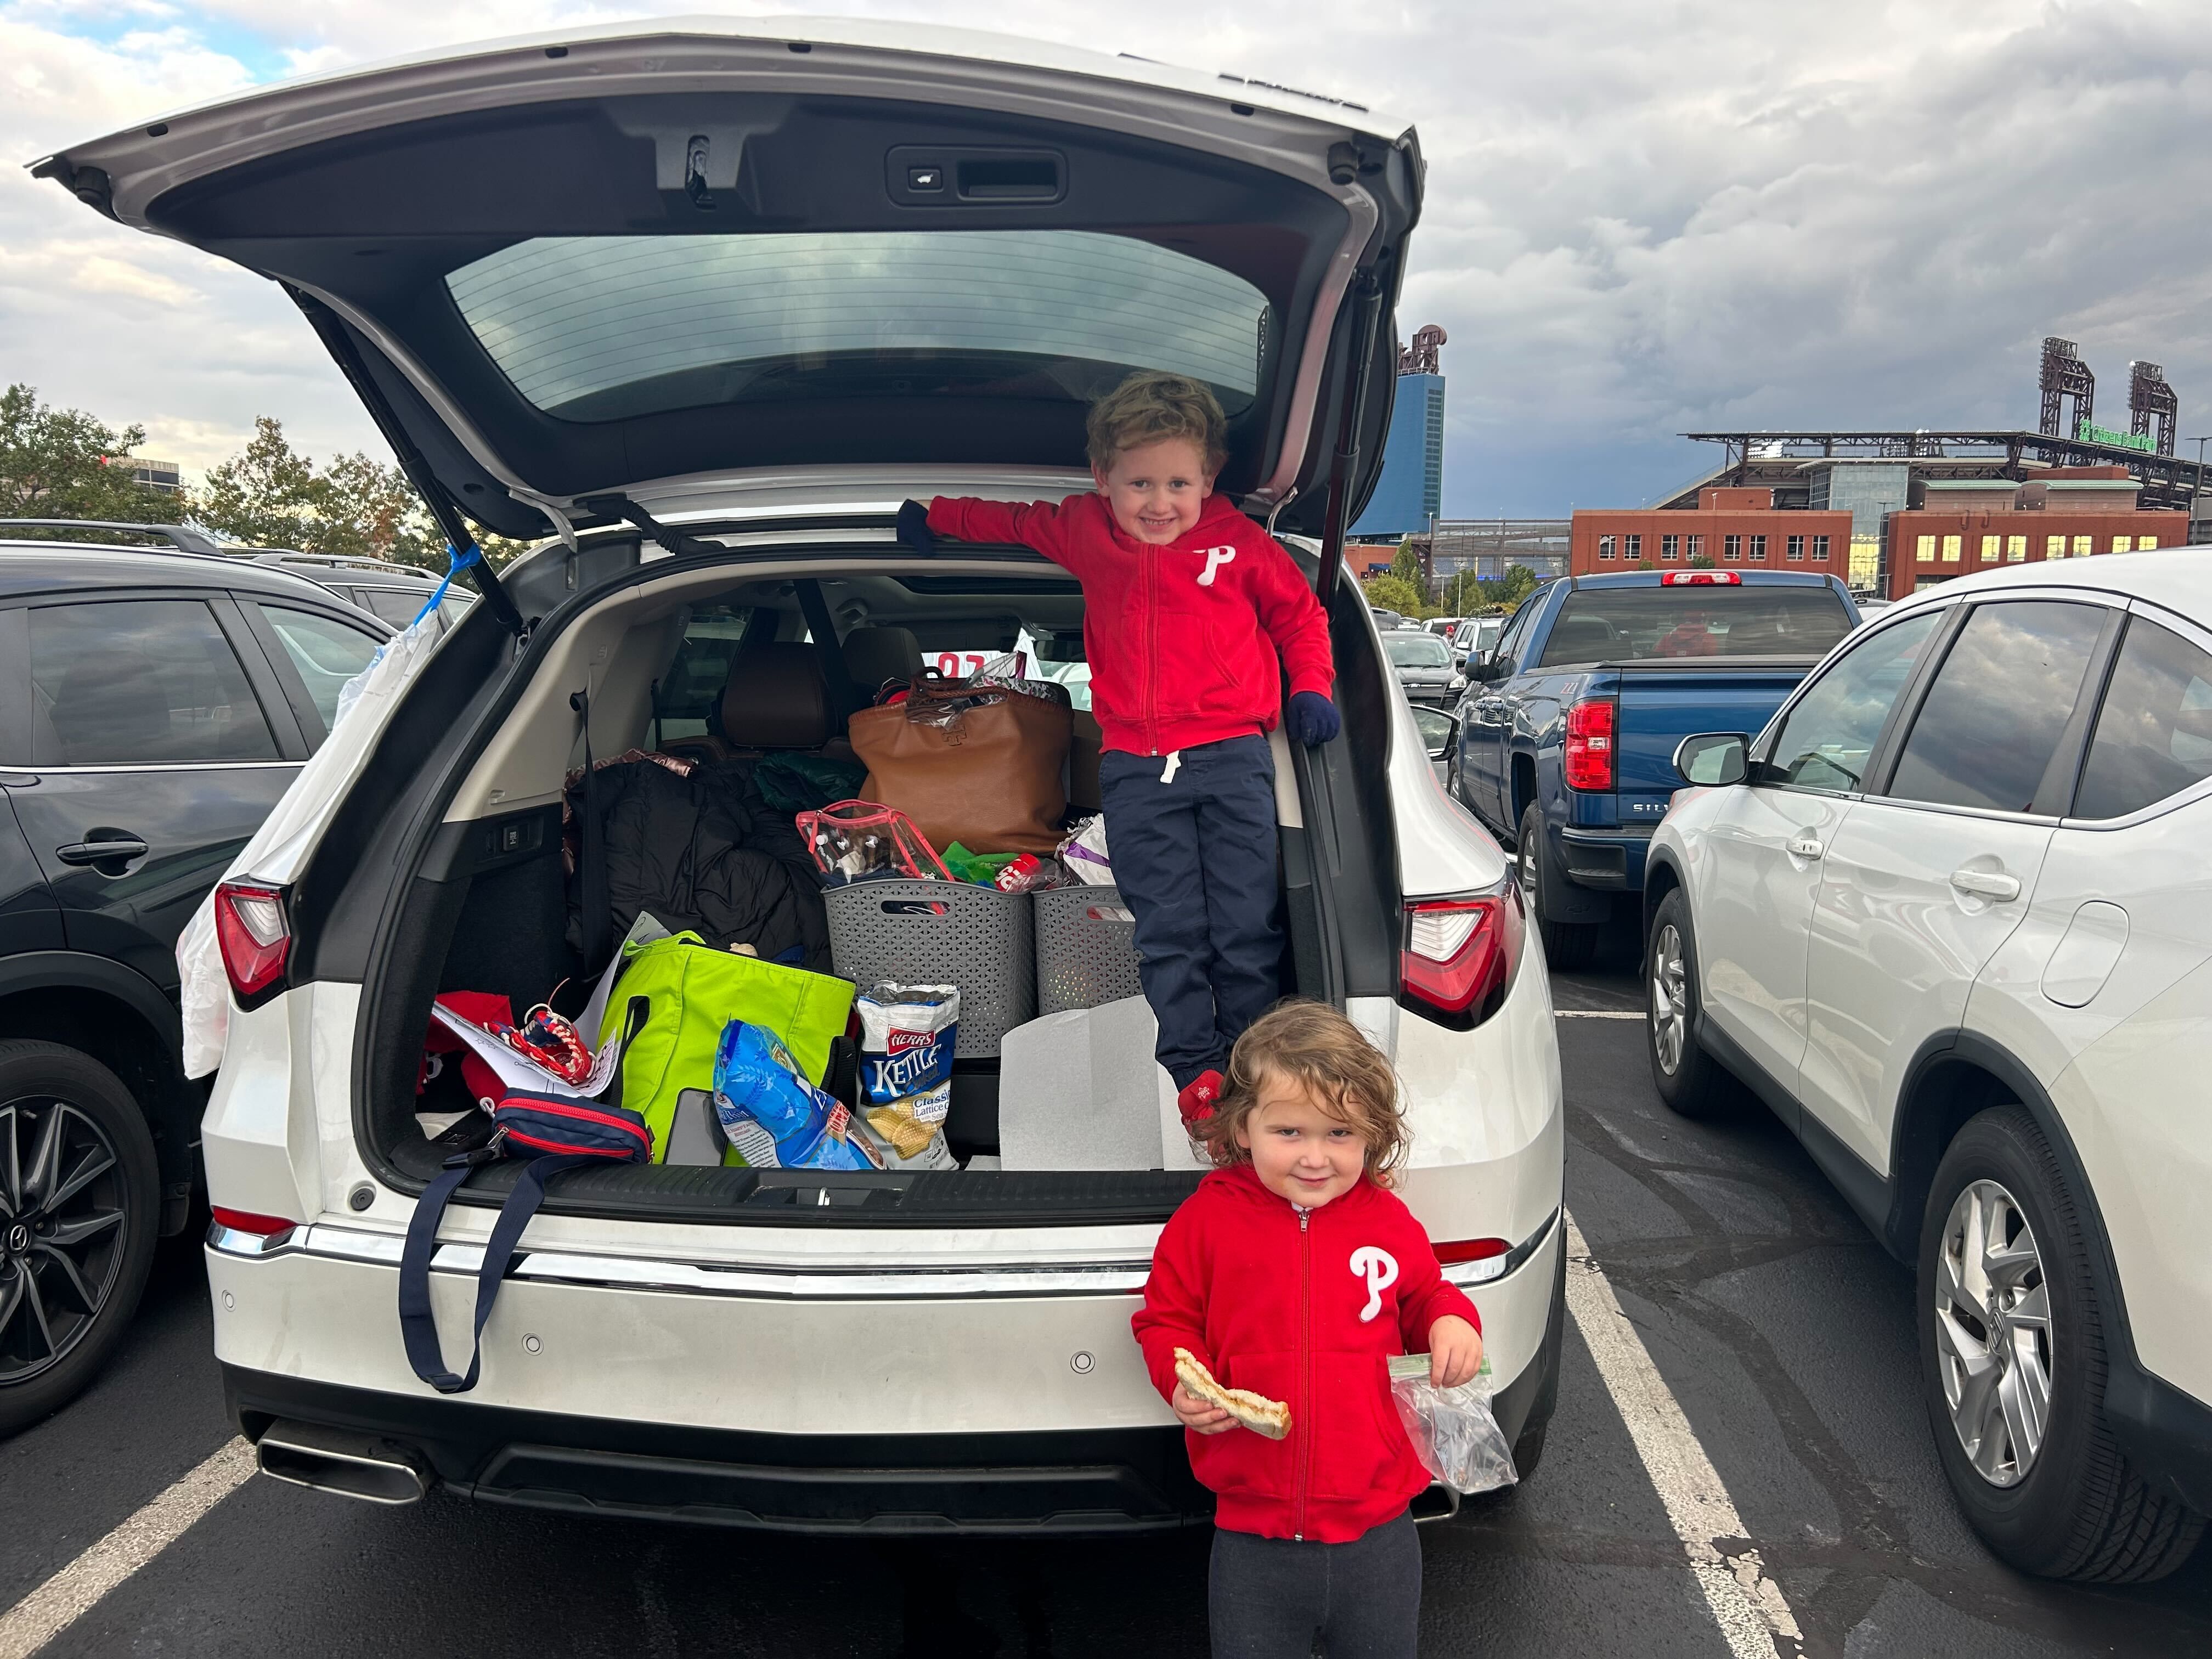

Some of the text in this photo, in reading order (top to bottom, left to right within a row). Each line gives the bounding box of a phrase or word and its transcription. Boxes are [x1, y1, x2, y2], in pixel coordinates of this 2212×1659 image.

[2093, 425, 2157, 452] Citizens Bank Park
[1192, 545, 1236, 587] P
[891, 1033, 932, 1046] HERR'S
[872, 1043, 941, 1097] KETTLE
[916, 1104, 944, 1117] Lattice
[1349, 1246, 1399, 1323] P
